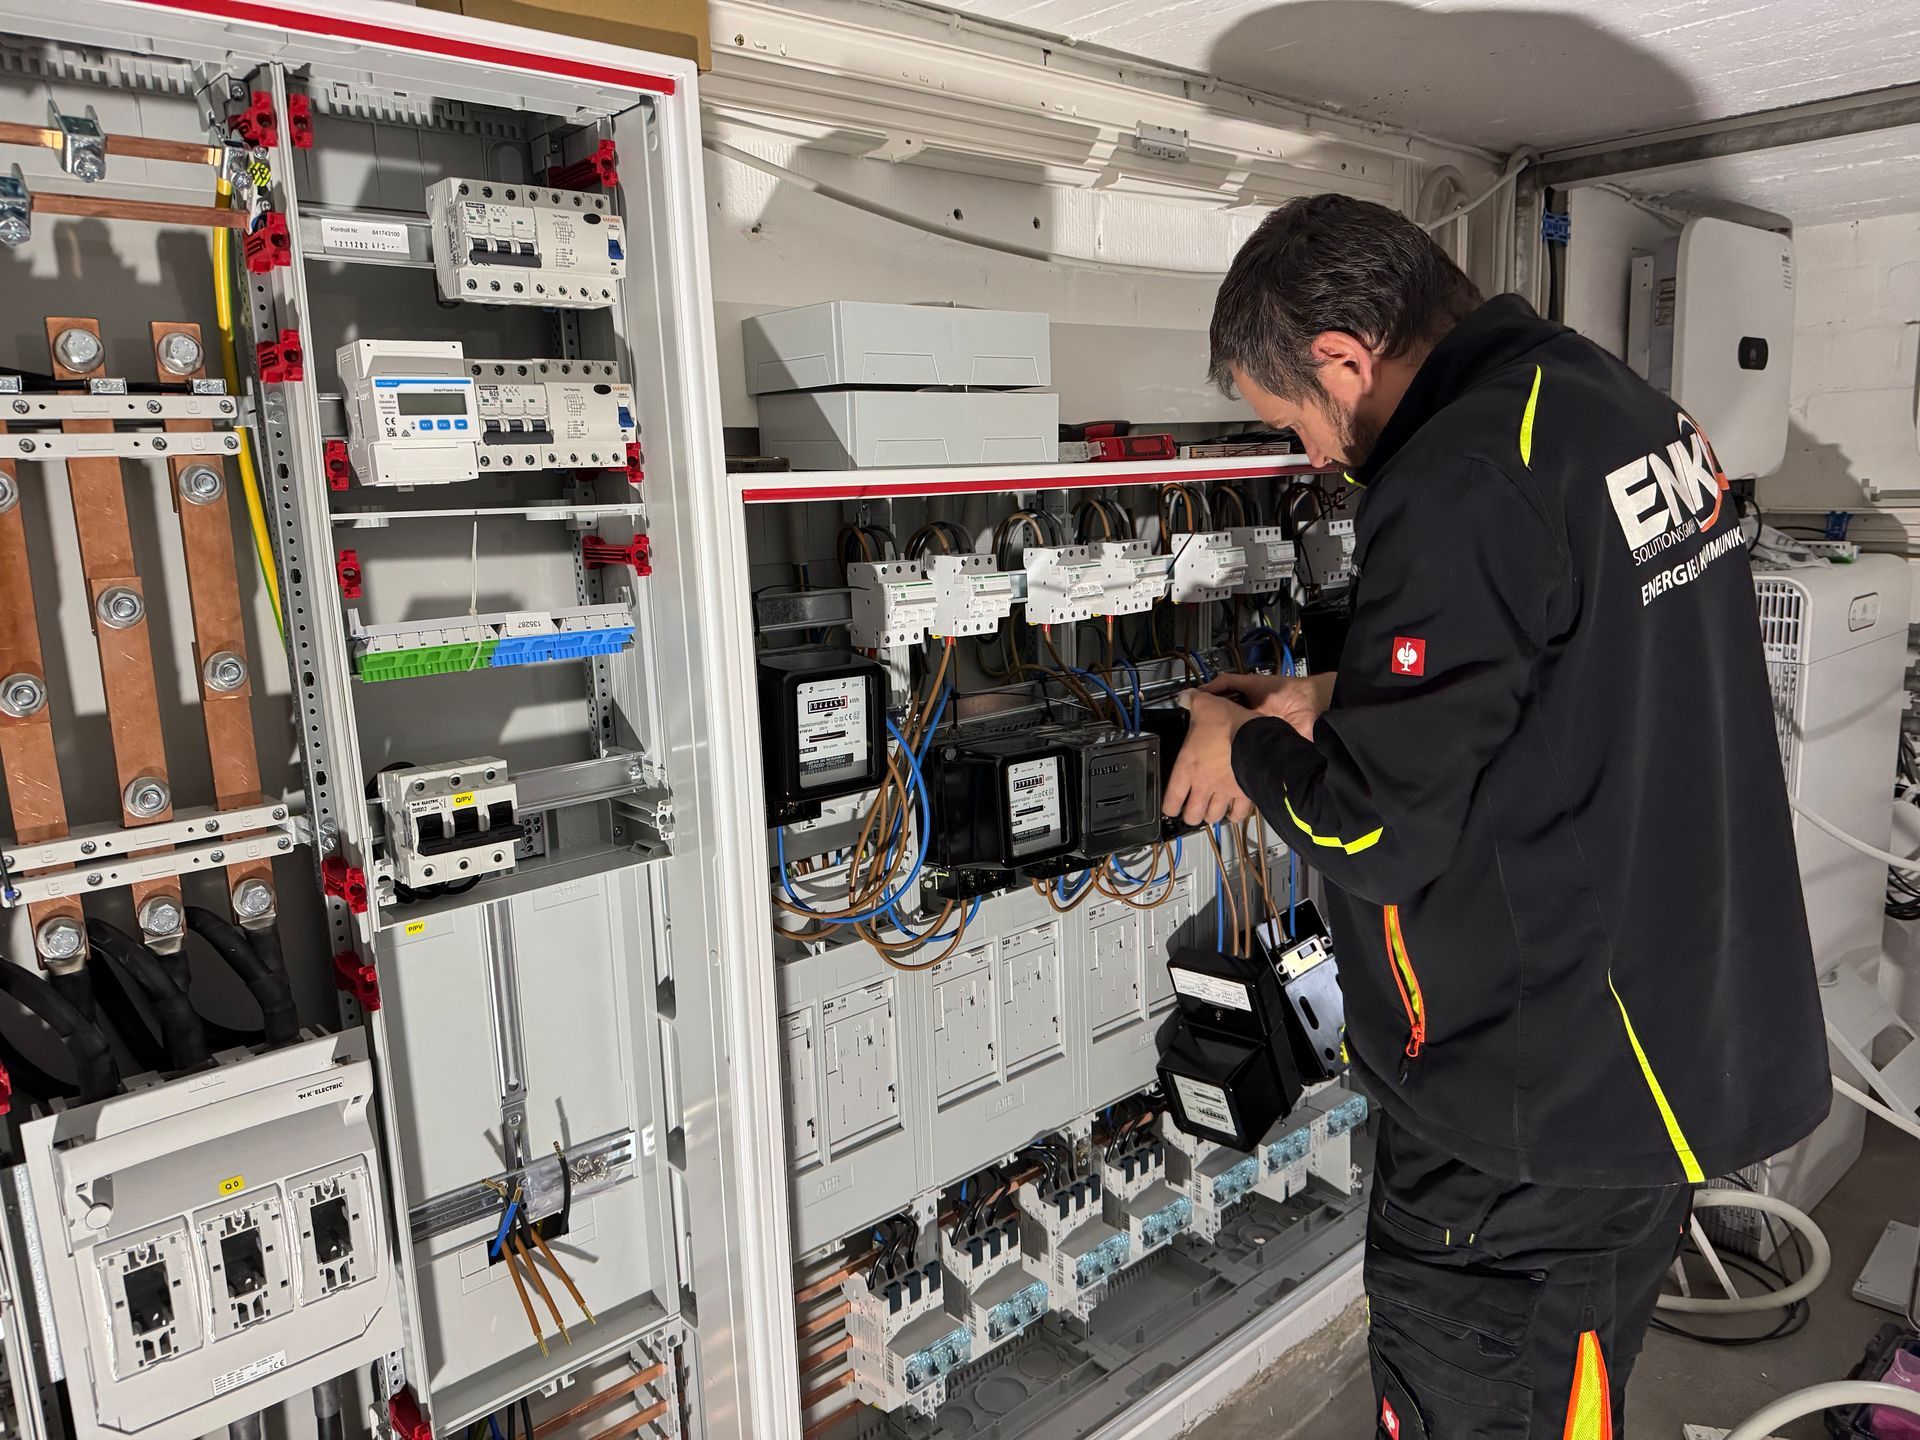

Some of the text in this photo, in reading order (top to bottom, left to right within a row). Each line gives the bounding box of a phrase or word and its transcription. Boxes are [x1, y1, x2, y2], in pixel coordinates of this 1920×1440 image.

[1641, 558, 1699, 607] ENERGIE
[455, 795, 472, 804] Q/PV
[823, 1002, 834, 1010] ABB
[314, 1082, 343, 1095] ELECTRIC
